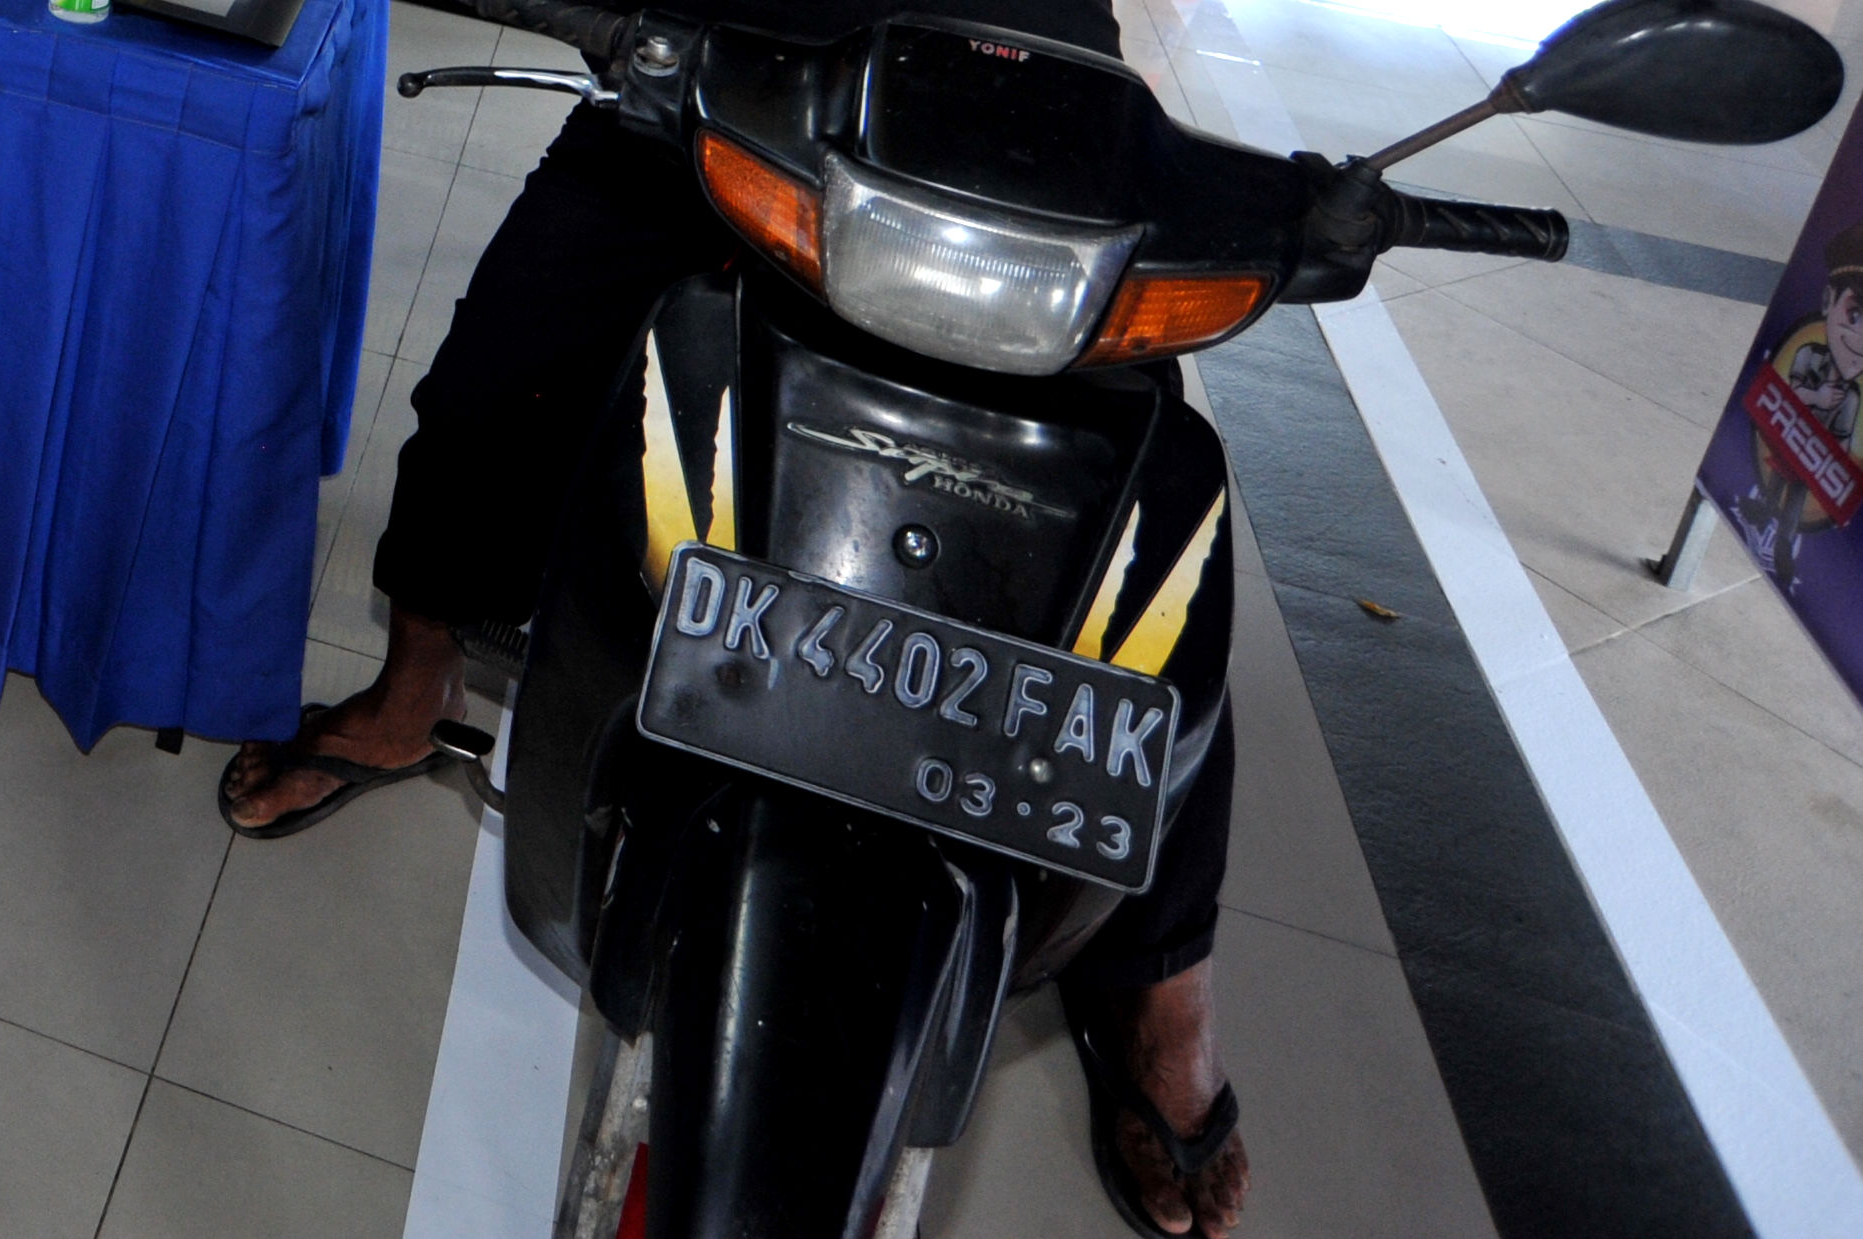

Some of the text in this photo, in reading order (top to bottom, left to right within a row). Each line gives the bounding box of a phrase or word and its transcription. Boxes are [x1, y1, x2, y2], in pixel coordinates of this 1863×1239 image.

[968, 39, 1031, 63] YONIF
[1756, 382, 1857, 508] PRESISI
[933, 473, 1030, 519] HONDA
[675, 556, 1164, 788] DK 4402 FAK
